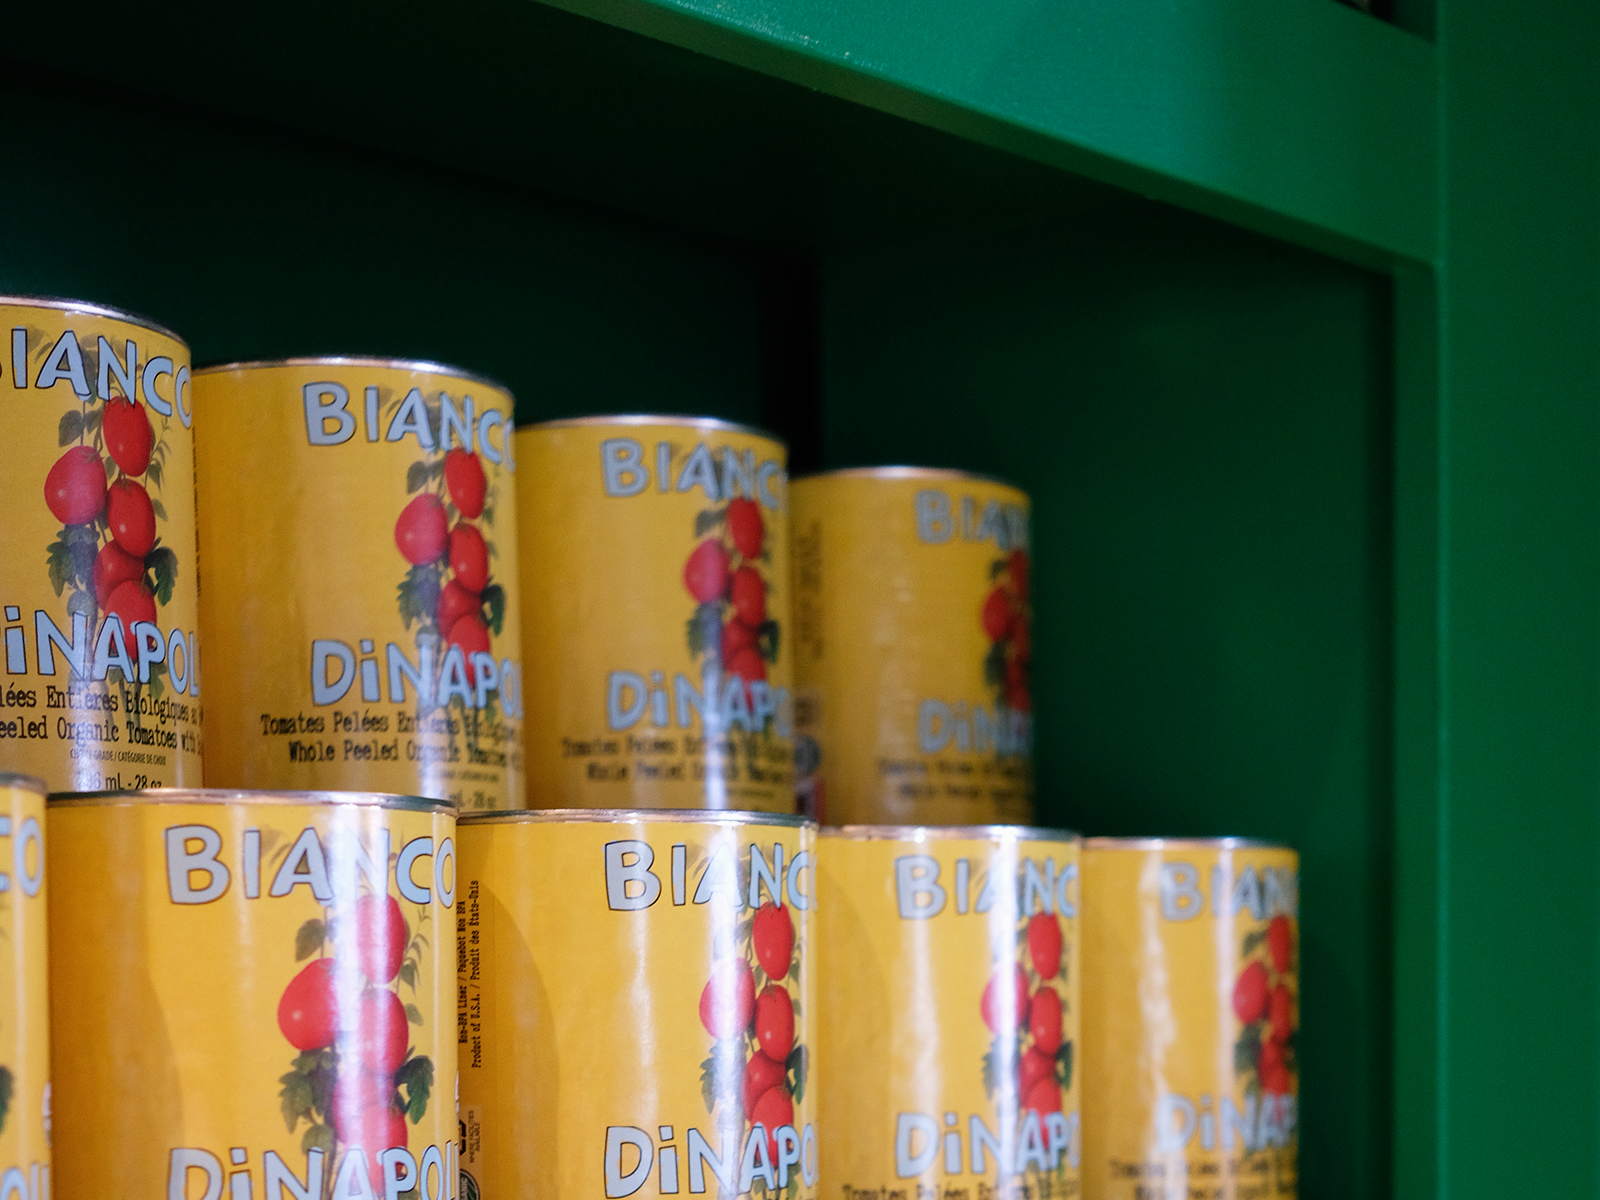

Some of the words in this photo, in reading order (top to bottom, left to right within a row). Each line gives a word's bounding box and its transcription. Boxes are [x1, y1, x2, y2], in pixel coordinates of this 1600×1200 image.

[0, 325, 192, 430] IANCO
[333, 708, 390, 733] Pelées
[343, 738, 399, 762] Peeled
[164, 824, 457, 908] BIANCO
[469, 929, 480, 945] des
[469, 950, 481, 981] Produit
[471, 1021, 481, 1032] of
[471, 1033, 482, 1069] Product
